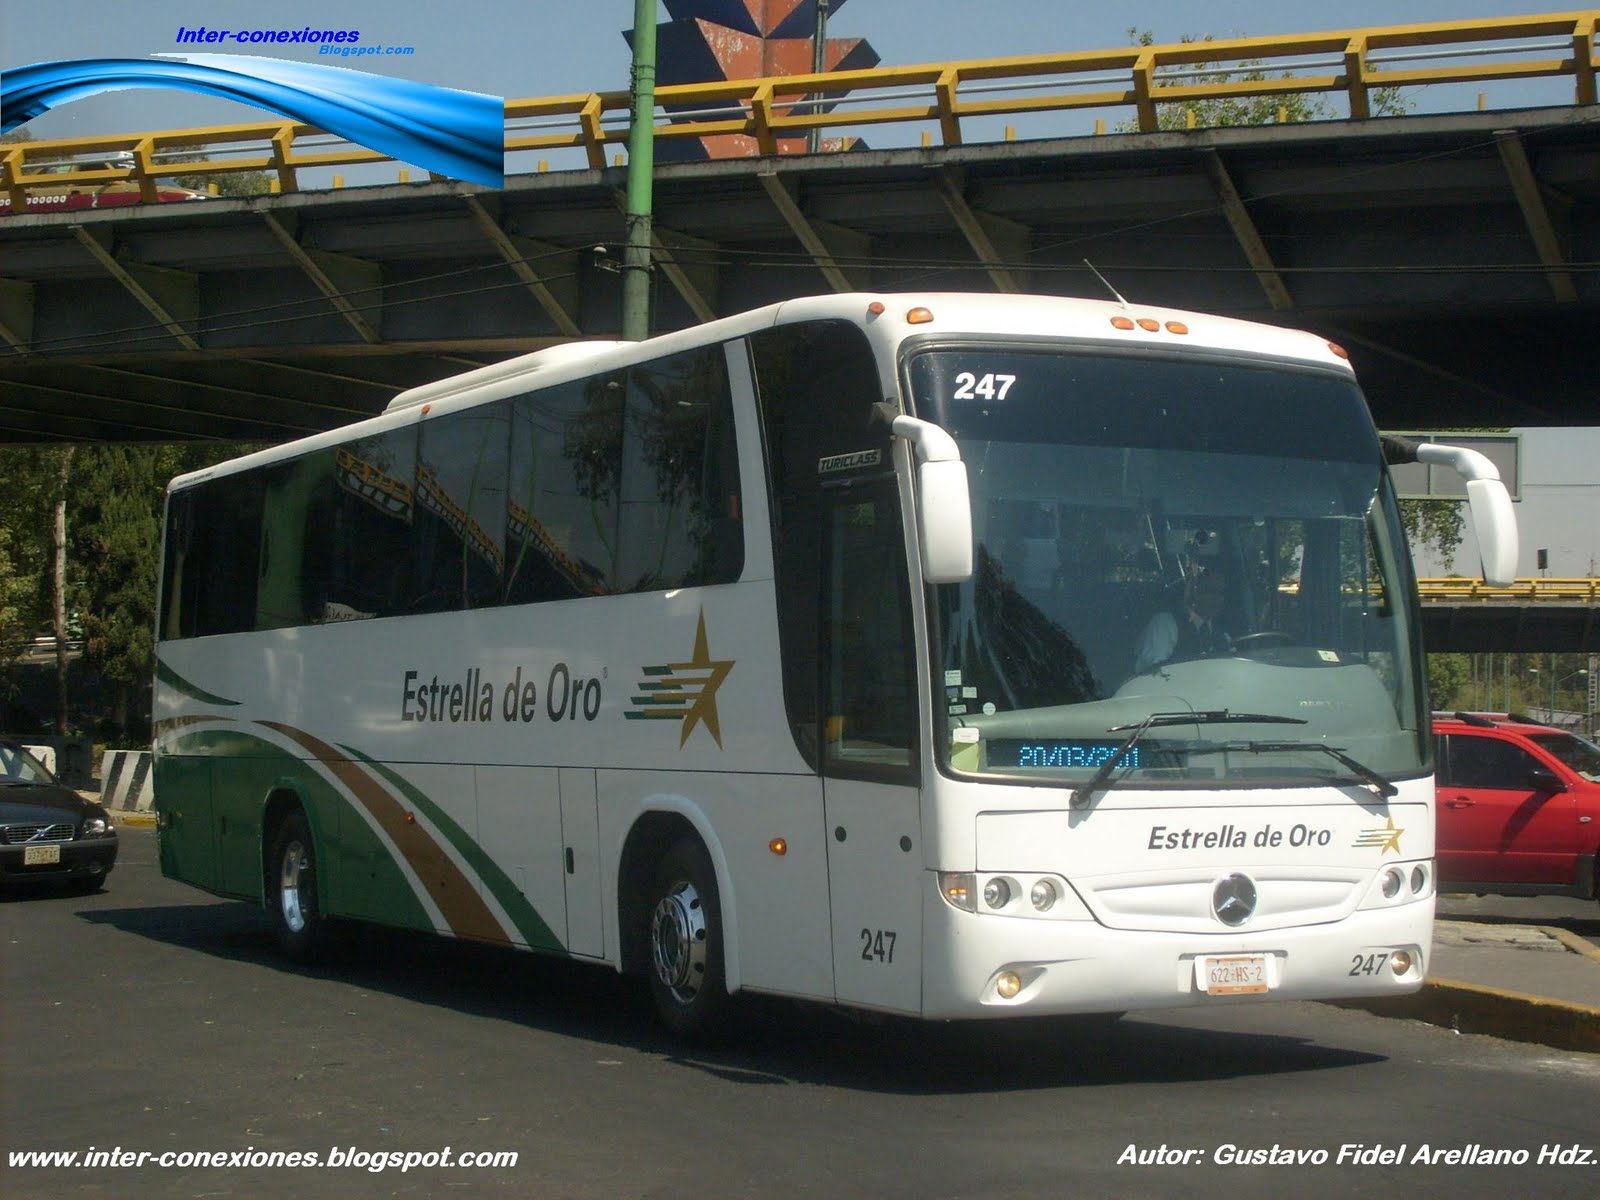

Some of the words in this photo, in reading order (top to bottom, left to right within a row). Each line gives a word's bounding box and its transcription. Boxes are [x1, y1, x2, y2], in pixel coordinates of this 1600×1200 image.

[953, 371, 1016, 401] 247
[820, 451, 878, 471] TURICLASS
[401, 667, 494, 723] Estrella
[503, 665, 537, 723] de
[546, 662, 602, 723] Oro
[1148, 824, 1246, 850] Estrella
[1254, 824, 1282, 848] de
[1289, 822, 1331, 848] Oro
[860, 928, 897, 964] 247
[1210, 965, 1264, 983] 622-HS-2
[1348, 953, 1388, 977] 247
